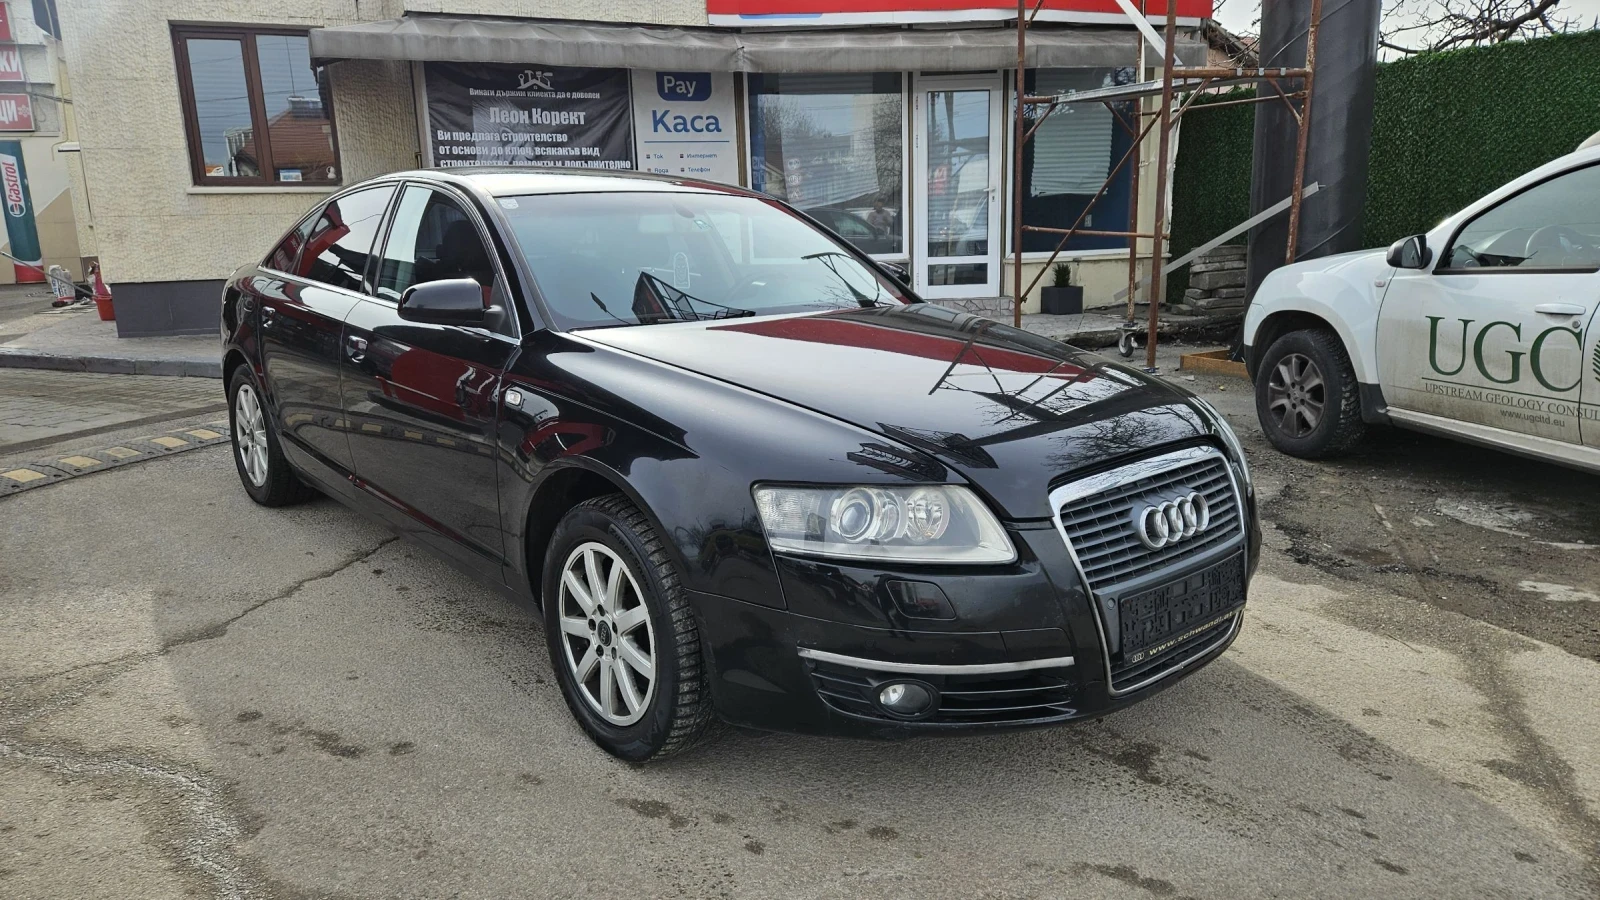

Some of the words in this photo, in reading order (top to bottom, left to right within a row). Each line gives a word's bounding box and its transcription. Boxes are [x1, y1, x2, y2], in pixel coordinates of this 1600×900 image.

[663, 75, 696, 97] Pay
[489, 107, 530, 124] Леон
[531, 108, 586, 126] Корект
[652, 110, 722, 133] Каса
[437, 130, 452, 141] Ви
[452, 132, 500, 143] предлага
[501, 132, 568, 143] строителство
[439, 146, 451, 155] от
[452, 146, 488, 156] основи
[490, 146, 504, 156] до
[535, 147, 580, 156] всякакъв
[581, 147, 600, 157] вид
[2, 162, 22, 203] Castrol
[1425, 316, 1582, 392] UGC
[1425, 382, 1483, 402] UPSTREAM
[1485, 392, 1545, 412] GEOLOGY
[1500, 409, 1566, 428] www.ugcltd.eu
